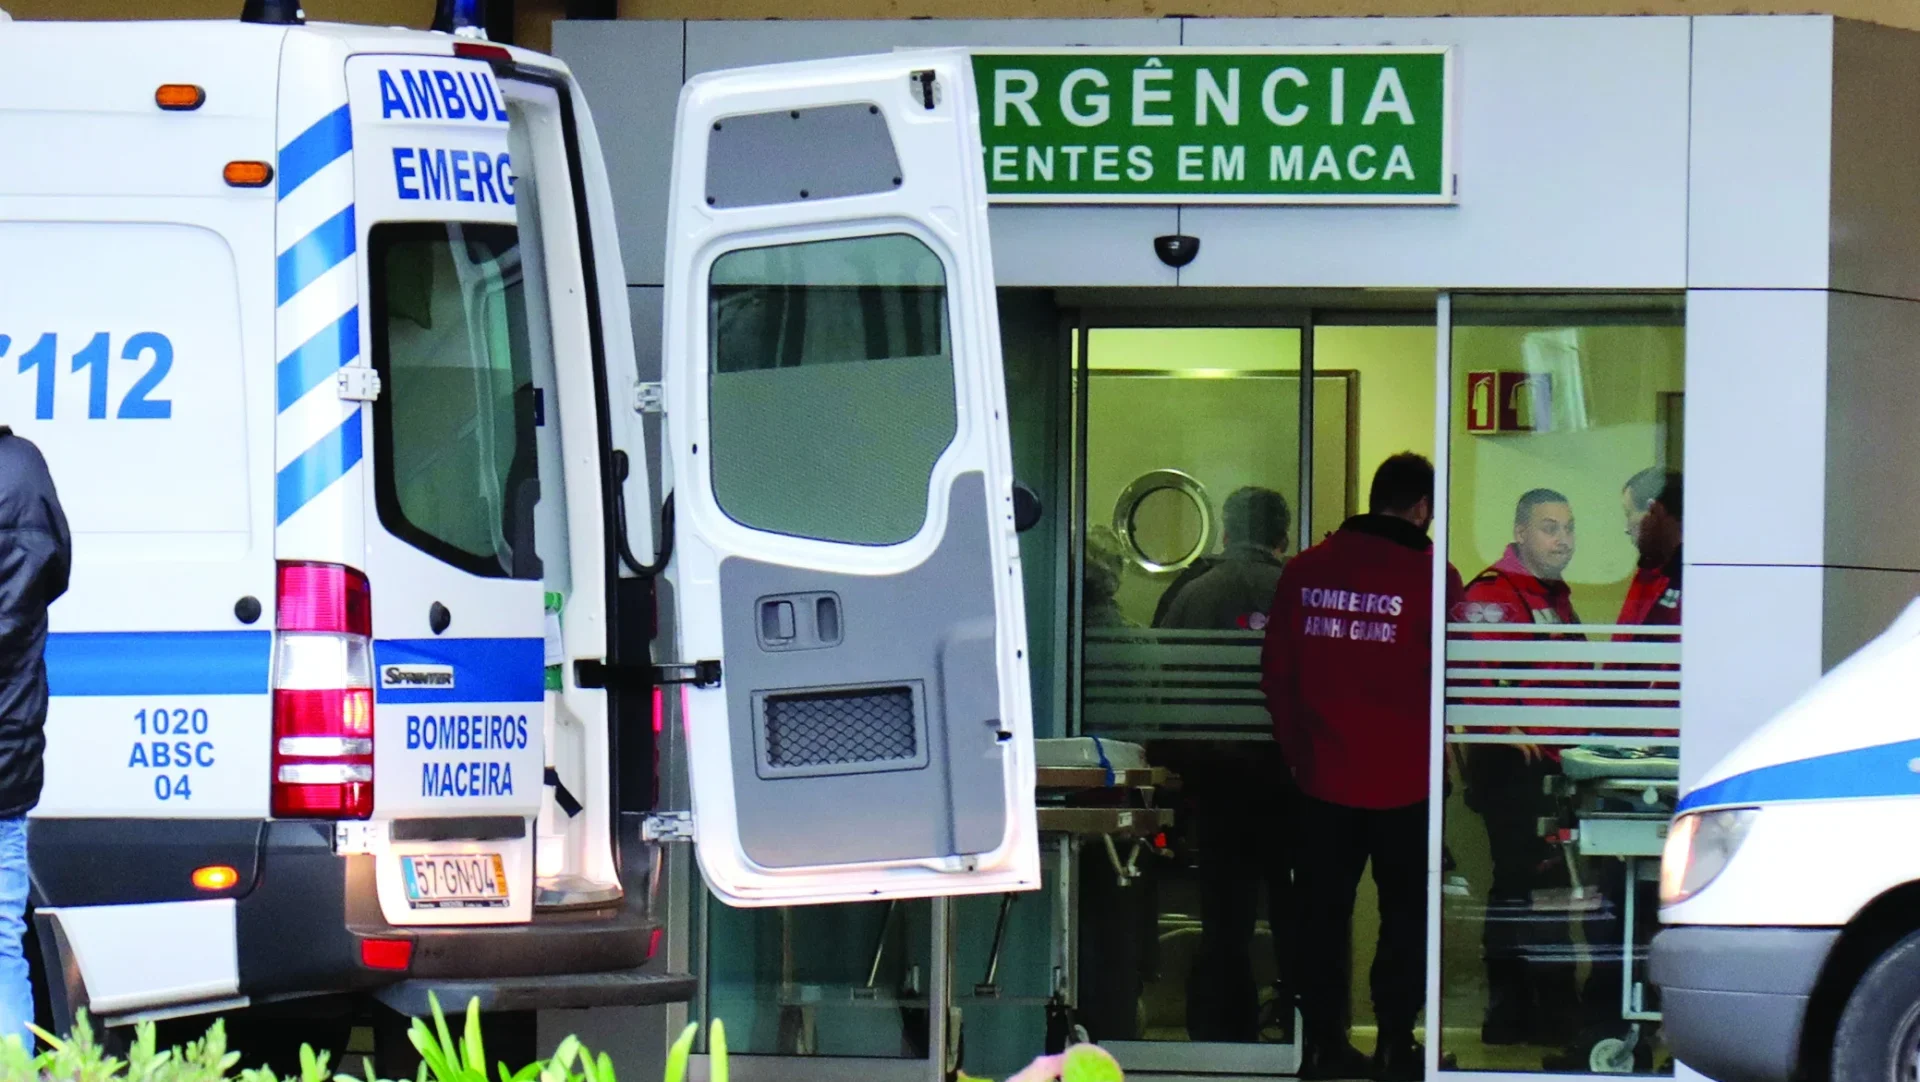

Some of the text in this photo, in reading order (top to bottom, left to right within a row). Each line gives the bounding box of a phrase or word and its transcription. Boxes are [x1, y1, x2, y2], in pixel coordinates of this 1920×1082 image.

[378, 69, 509, 122] AMBUL
[993, 57, 1415, 127] RGÊNCIA
[392, 147, 516, 205] EMERG
[982, 144, 1416, 181] ENTES EM MACA
[18, 331, 174, 420] 112
[1301, 587, 1403, 616] BOMBEIROS
[134, 708, 208, 735] 1020
[406, 715, 527, 750] BOMBEIROS
[128, 741, 215, 768] ABSC
[154, 774, 192, 801] 04
[422, 762, 513, 797] MACEIRA
